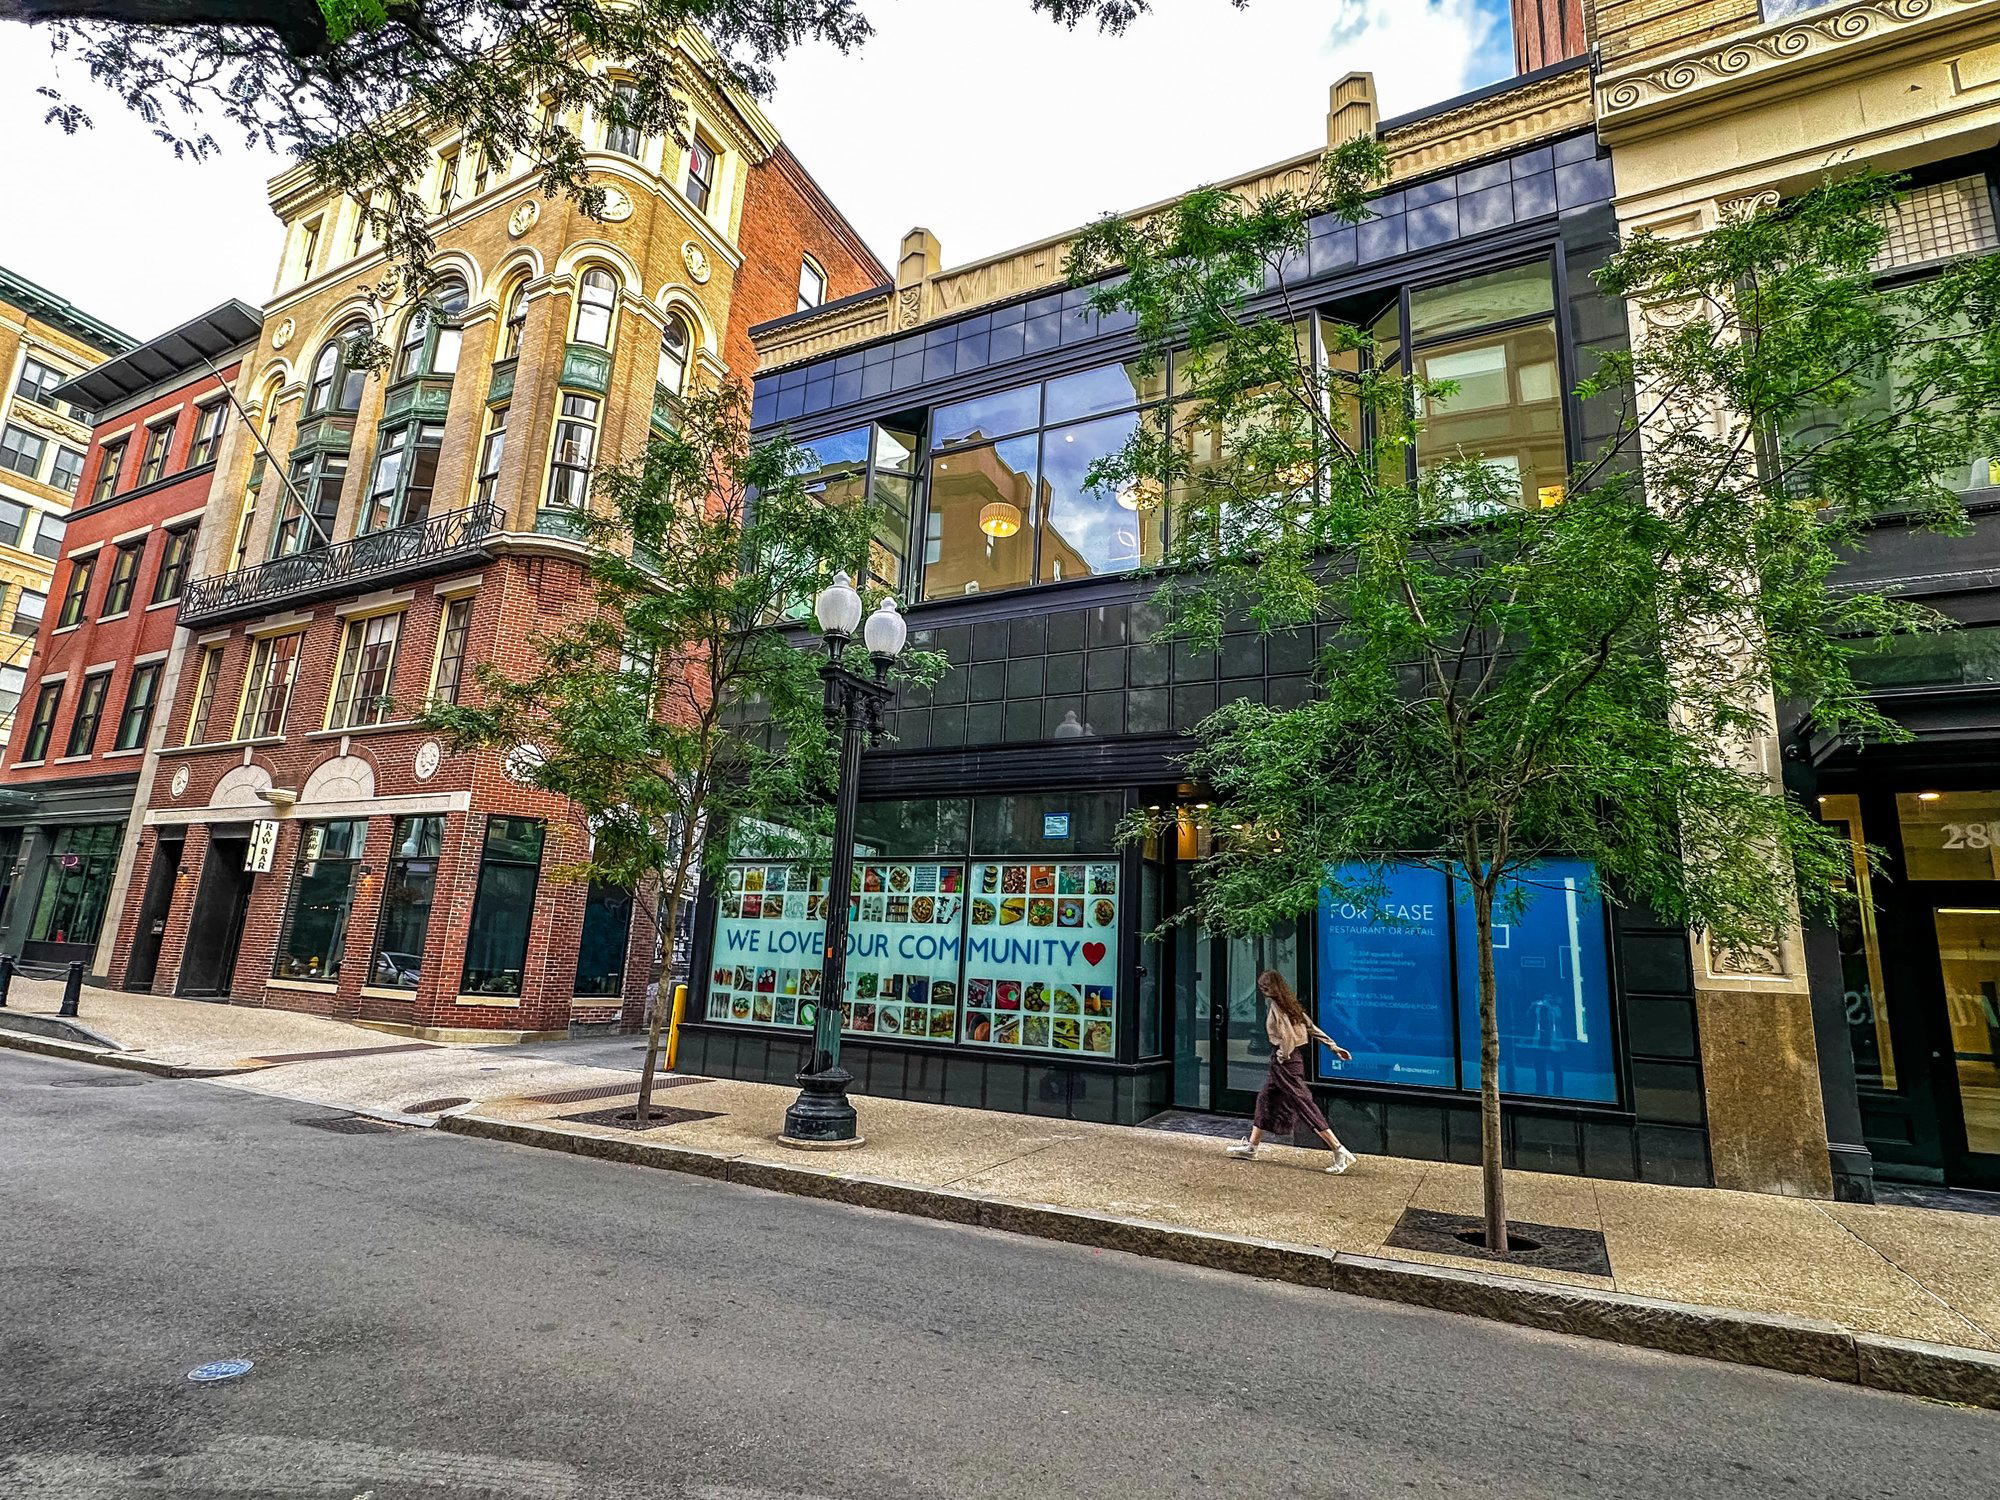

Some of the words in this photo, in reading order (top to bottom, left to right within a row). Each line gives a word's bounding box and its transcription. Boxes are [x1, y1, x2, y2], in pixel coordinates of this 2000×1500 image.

[262, 823, 273, 844] RAW
[1941, 822, 2000, 850] 28
[258, 848, 268, 869] BAR
[1330, 902, 1368, 920] FOR
[1376, 904, 1434, 921] EASE
[1329, 925, 1386, 935] RESTAURANT
[1388, 926, 1402, 936] OR
[1404, 927, 1436, 937] RETAIL
[727, 928, 761, 952] WE
[767, 930, 824, 955] LOVE
[898, 934, 1081, 967] COMMUNITY
